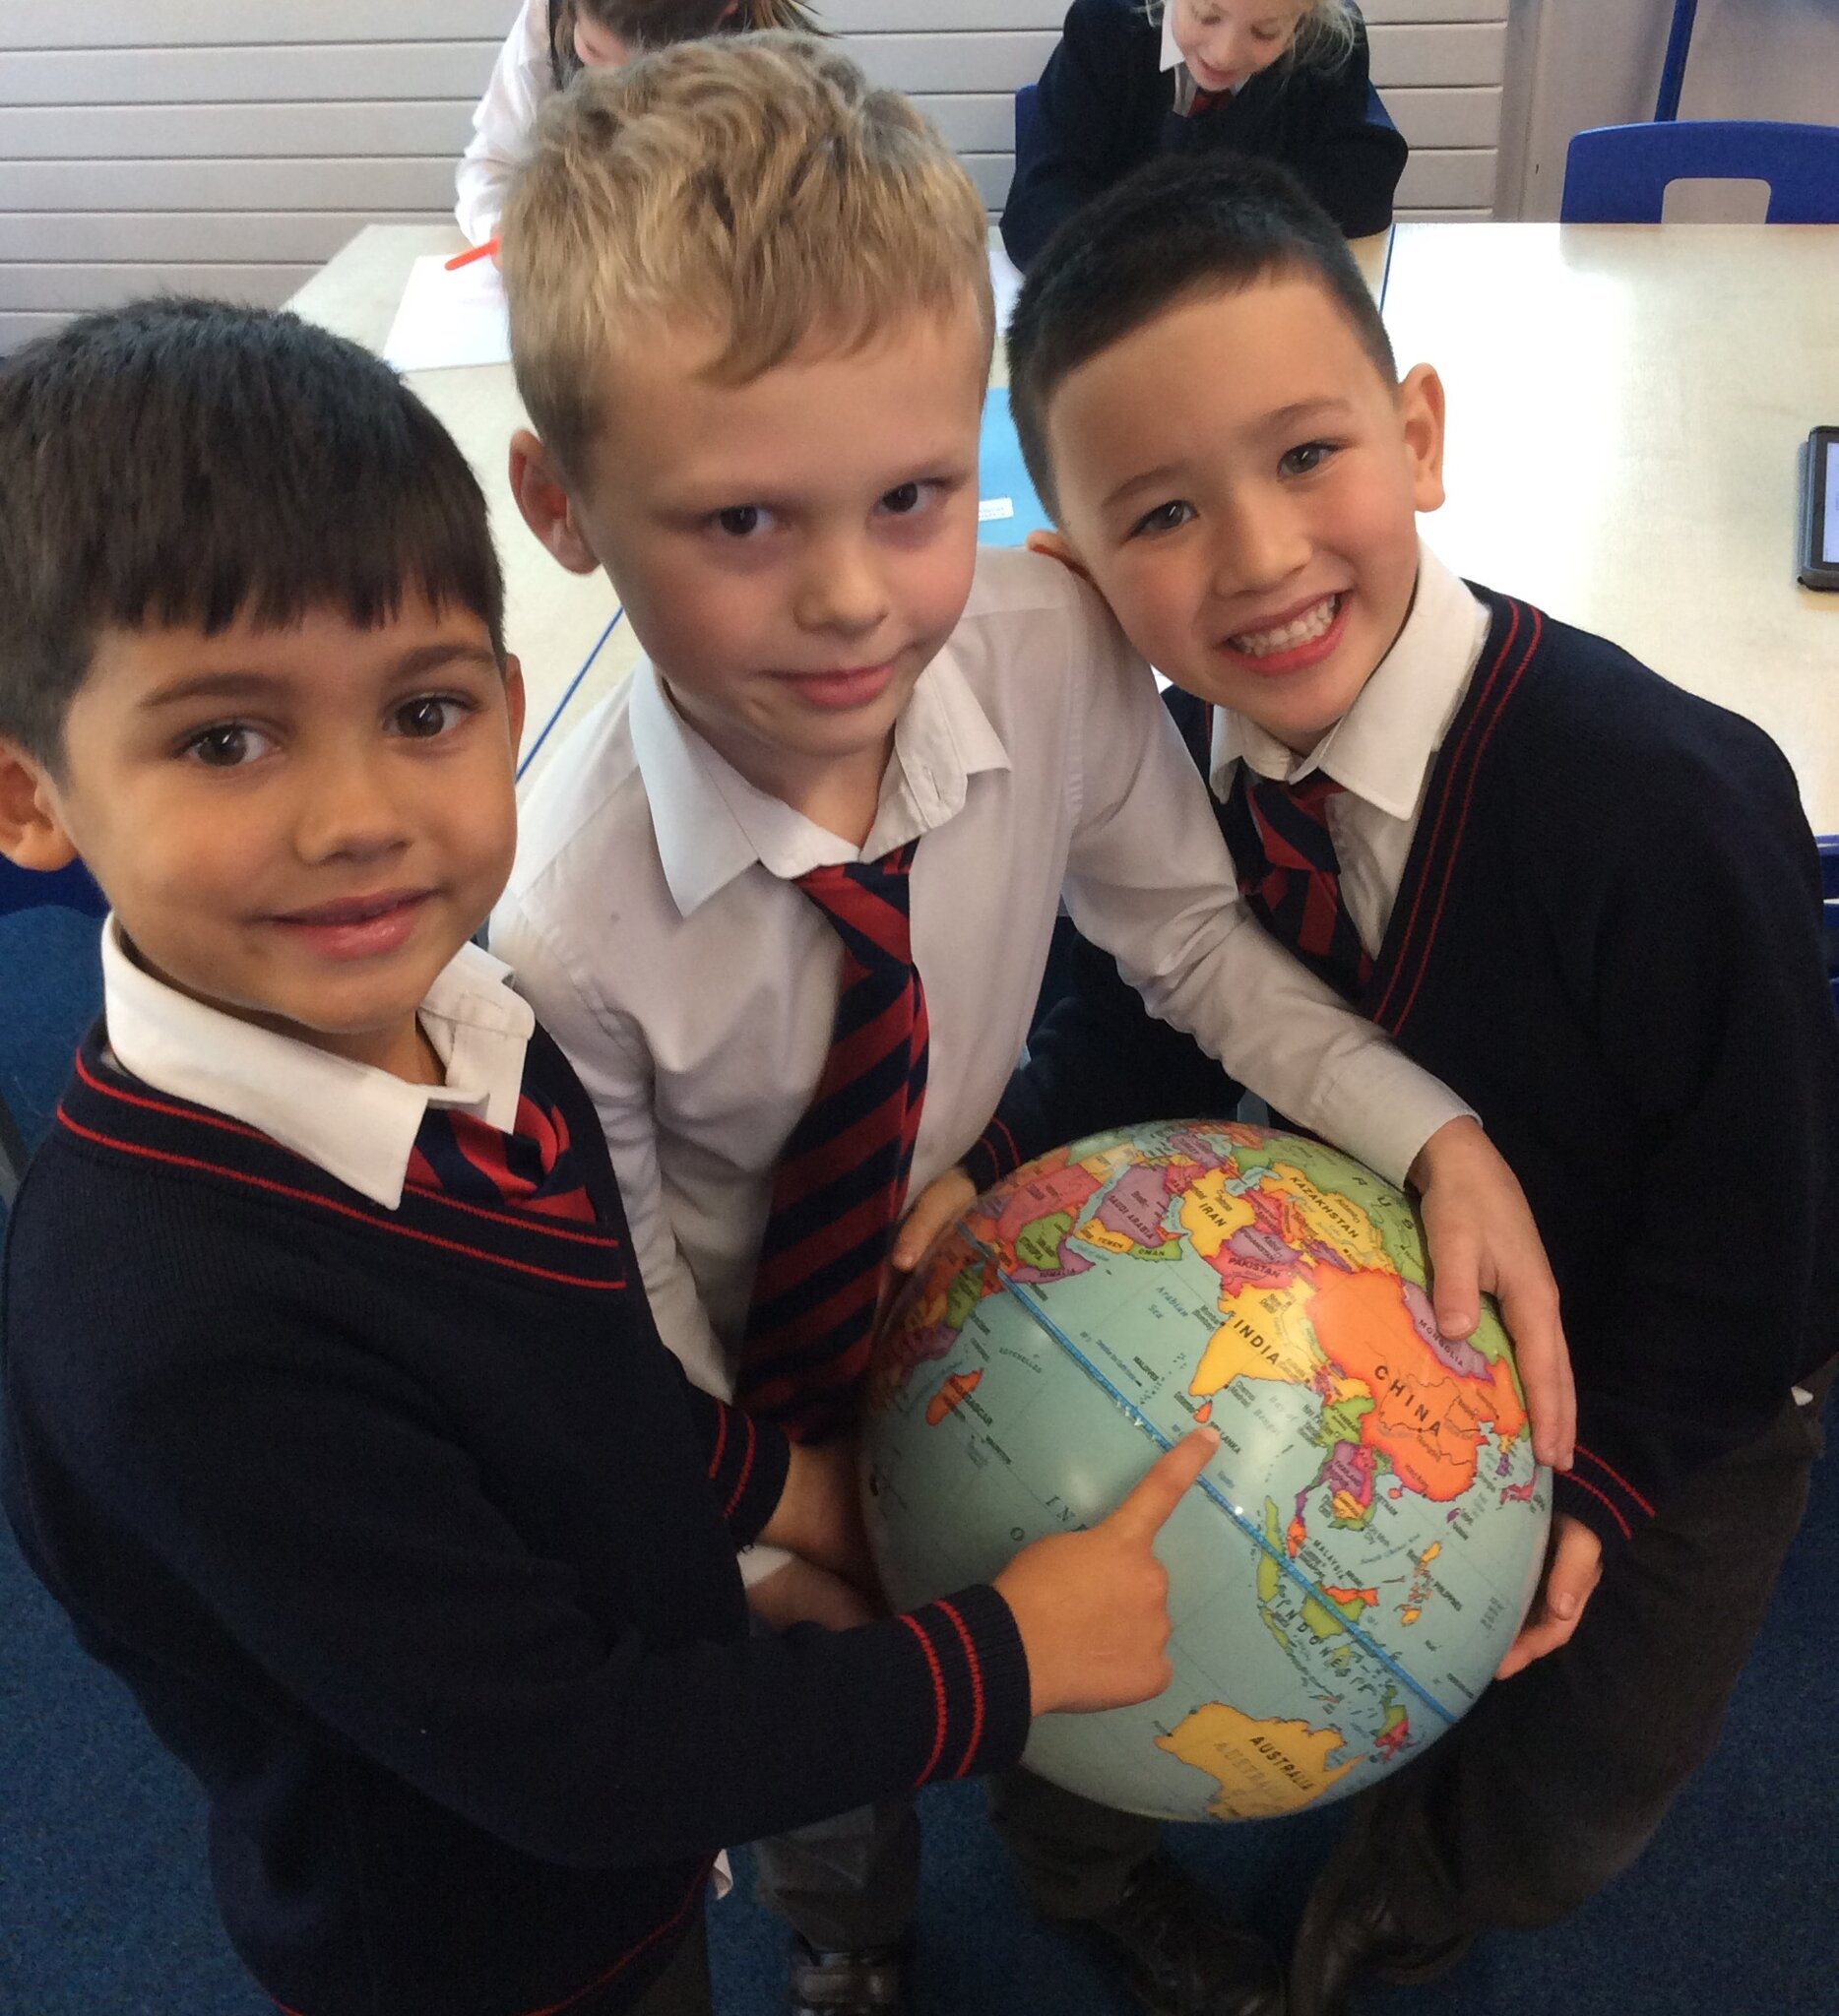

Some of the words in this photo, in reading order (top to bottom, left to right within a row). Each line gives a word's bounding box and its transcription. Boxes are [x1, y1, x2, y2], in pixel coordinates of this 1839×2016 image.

[1108, 1194, 1129, 1216] SAUDI
[1126, 1214, 1156, 1240] ARABIA
[1199, 1203, 1228, 1228] IRAN
[1290, 1175, 1360, 1238] KAZAKHSTAN
[1098, 1236, 1124, 1249] YEMEN
[1138, 1248, 1166, 1257] OMAN
[1229, 1257, 1281, 1278] PAKISTAN
[1148, 1304, 1164, 1319] Sea
[1157, 1287, 1188, 1317] Arabian
[1234, 1319, 1280, 1364] INDIA
[1419, 1319, 1464, 1367] MONGOLIA
[1374, 1365, 1440, 1437] CHINA
[1220, 1431, 1241, 1455] LANKA
[1313, 1540, 1344, 1581] MALAYSIA
[1249, 1736, 1314, 1791] AUSTRALIA
